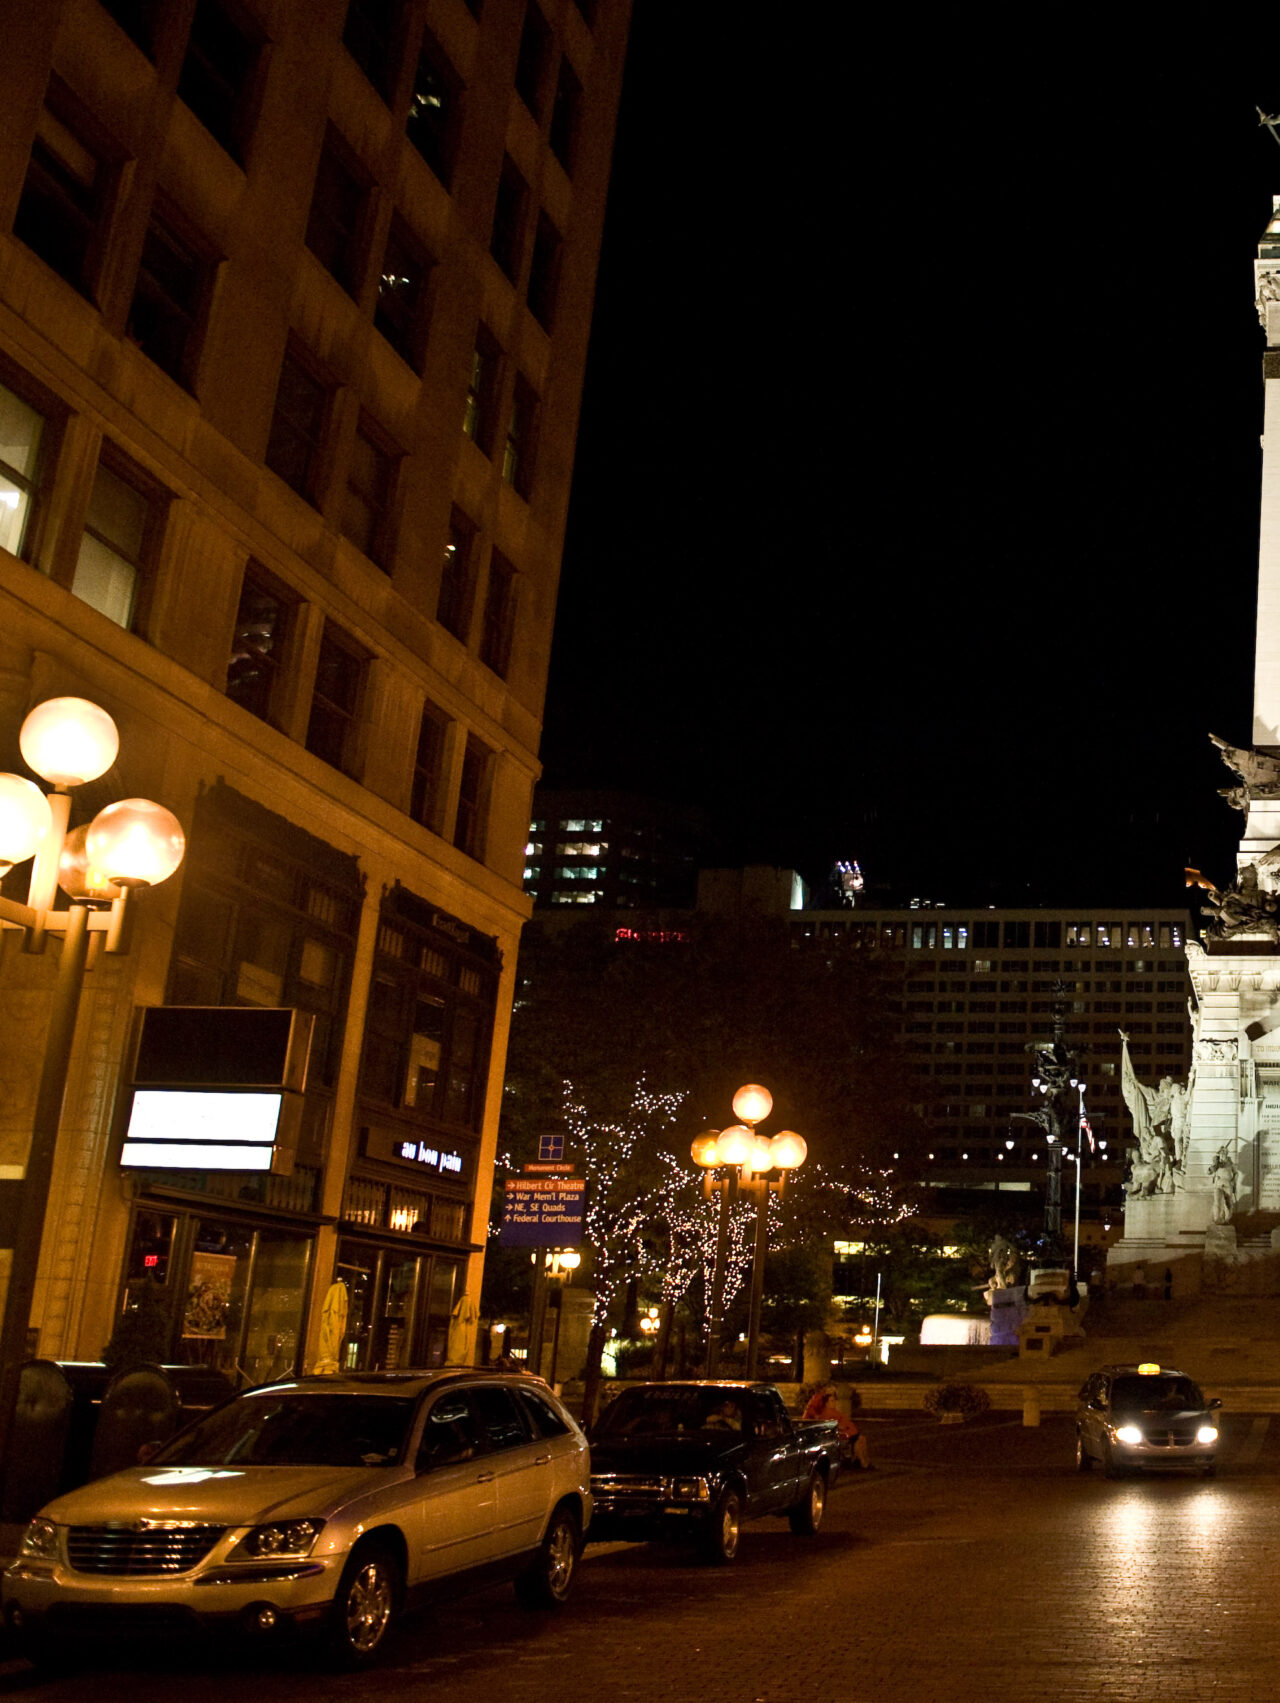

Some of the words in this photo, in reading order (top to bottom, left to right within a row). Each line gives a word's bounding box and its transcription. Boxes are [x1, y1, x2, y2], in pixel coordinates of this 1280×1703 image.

[401, 1142, 417, 1160] au
[417, 1140, 438, 1166] bon
[439, 1150, 462, 1173] pain
[516, 1181, 542, 1190] Hilbert
[544, 1181, 554, 1190] Cir
[557, 1181, 585, 1190] Theatre
[515, 1192, 531, 1201] War
[533, 1192, 556, 1201] Mem'l
[558, 1192, 580, 1201] Plaza
[514, 1203, 527, 1212] NE,
[530, 1203, 539, 1212] SE
[542, 1203, 566, 1212] Quads
[513, 1214, 539, 1223] Federal
[541, 1214, 582, 1223] Courthouse
